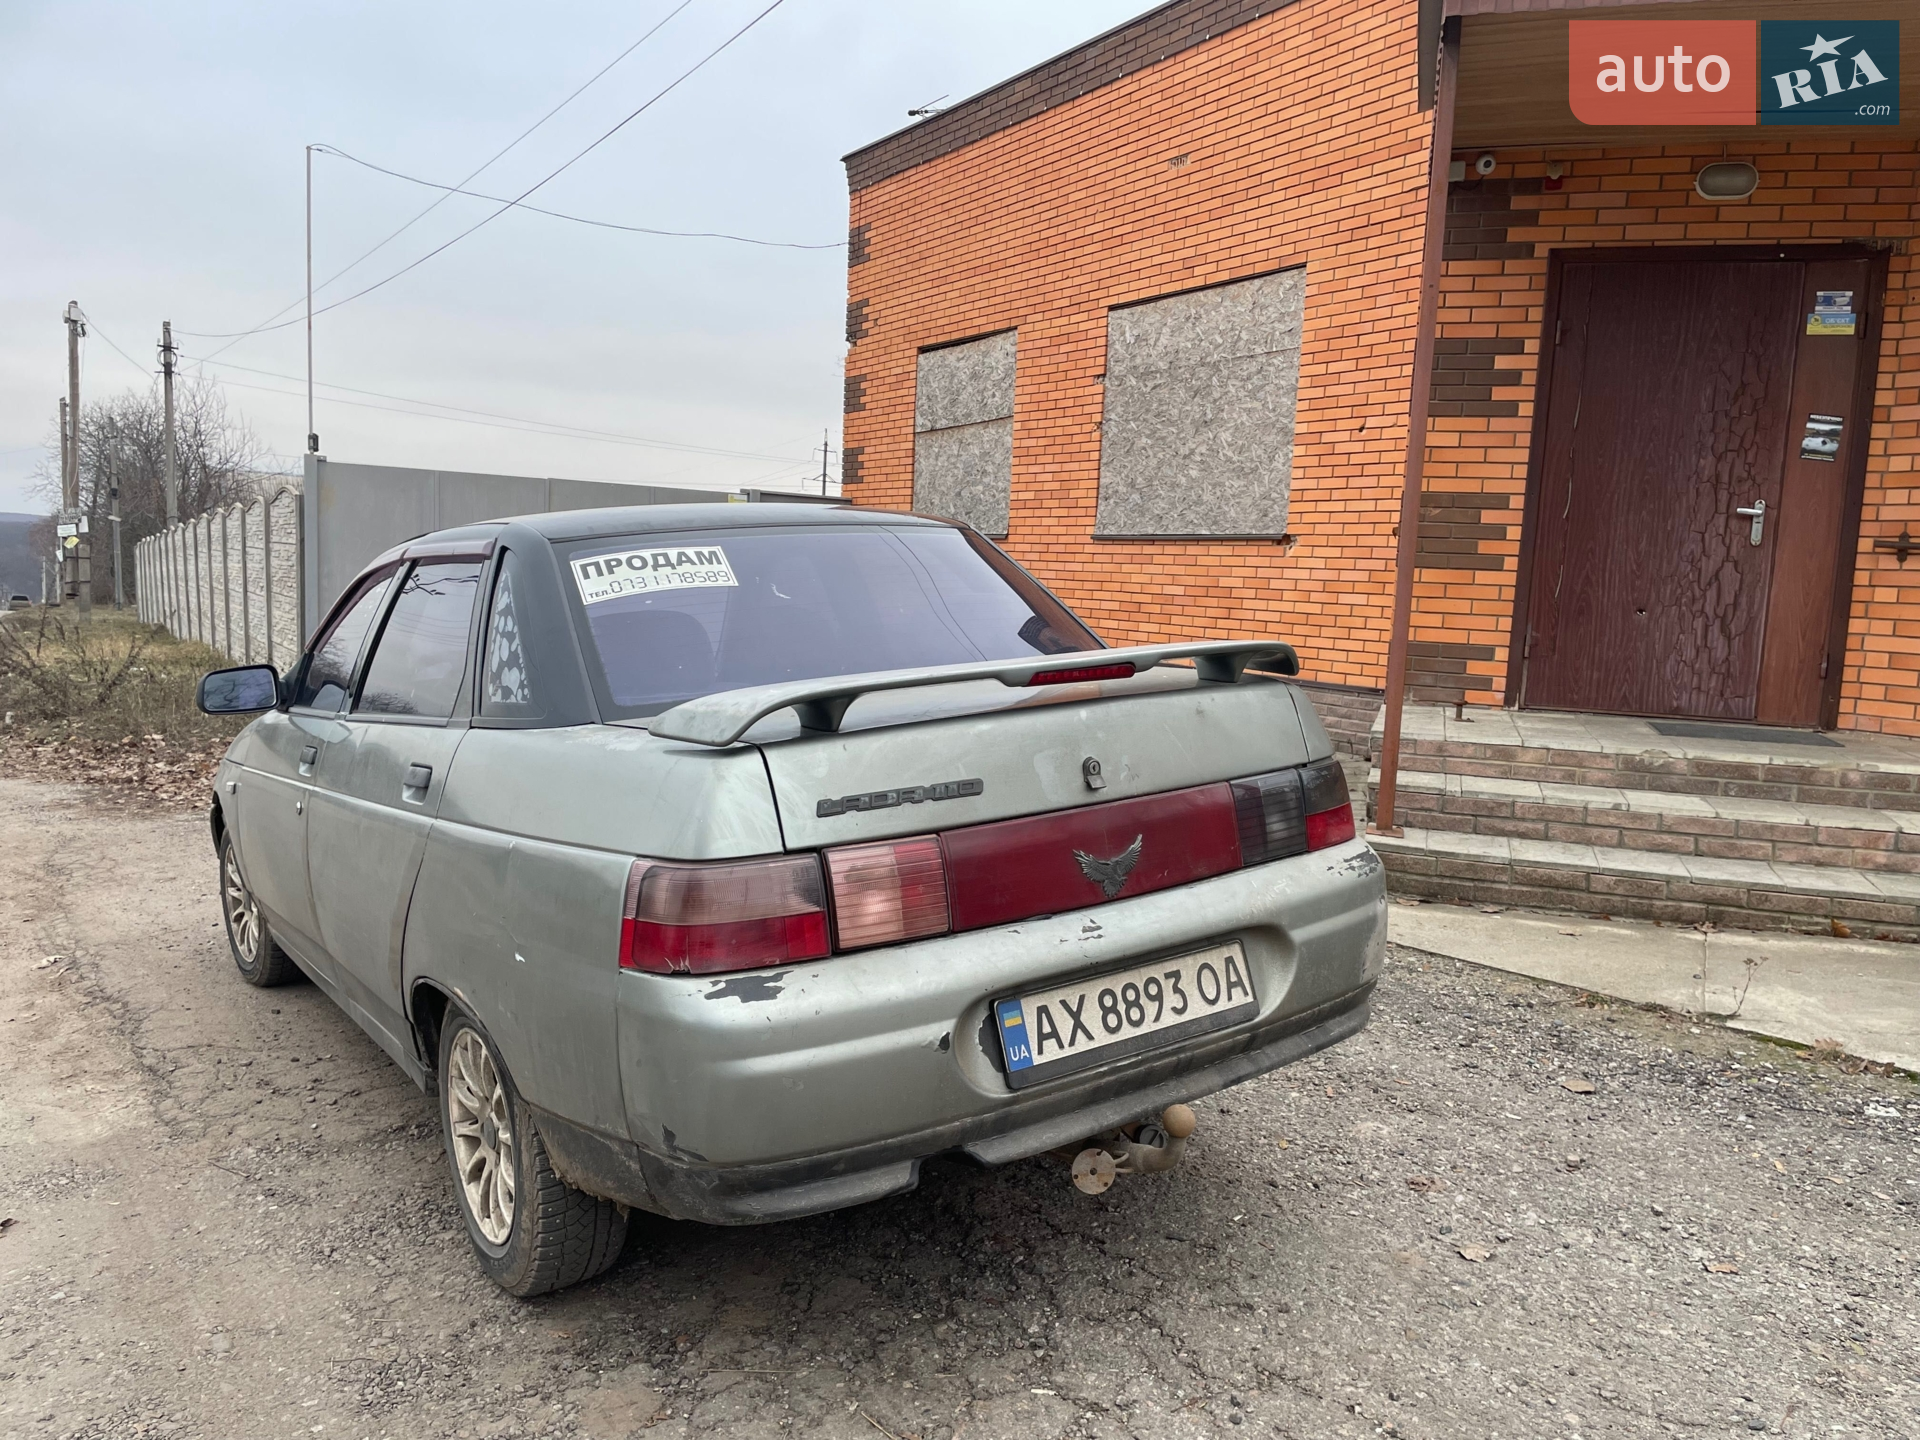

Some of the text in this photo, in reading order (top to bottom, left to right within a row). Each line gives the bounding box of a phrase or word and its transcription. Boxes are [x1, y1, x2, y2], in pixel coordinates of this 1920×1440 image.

[579, 550, 723, 580] ПРОДАМ
[609, 570, 731, 594] 0731178589
[817, 778, 984, 818] LADA 110
[1036, 955, 1249, 1055] AX 8893 OA
[1010, 1044, 1029, 1062] UA
